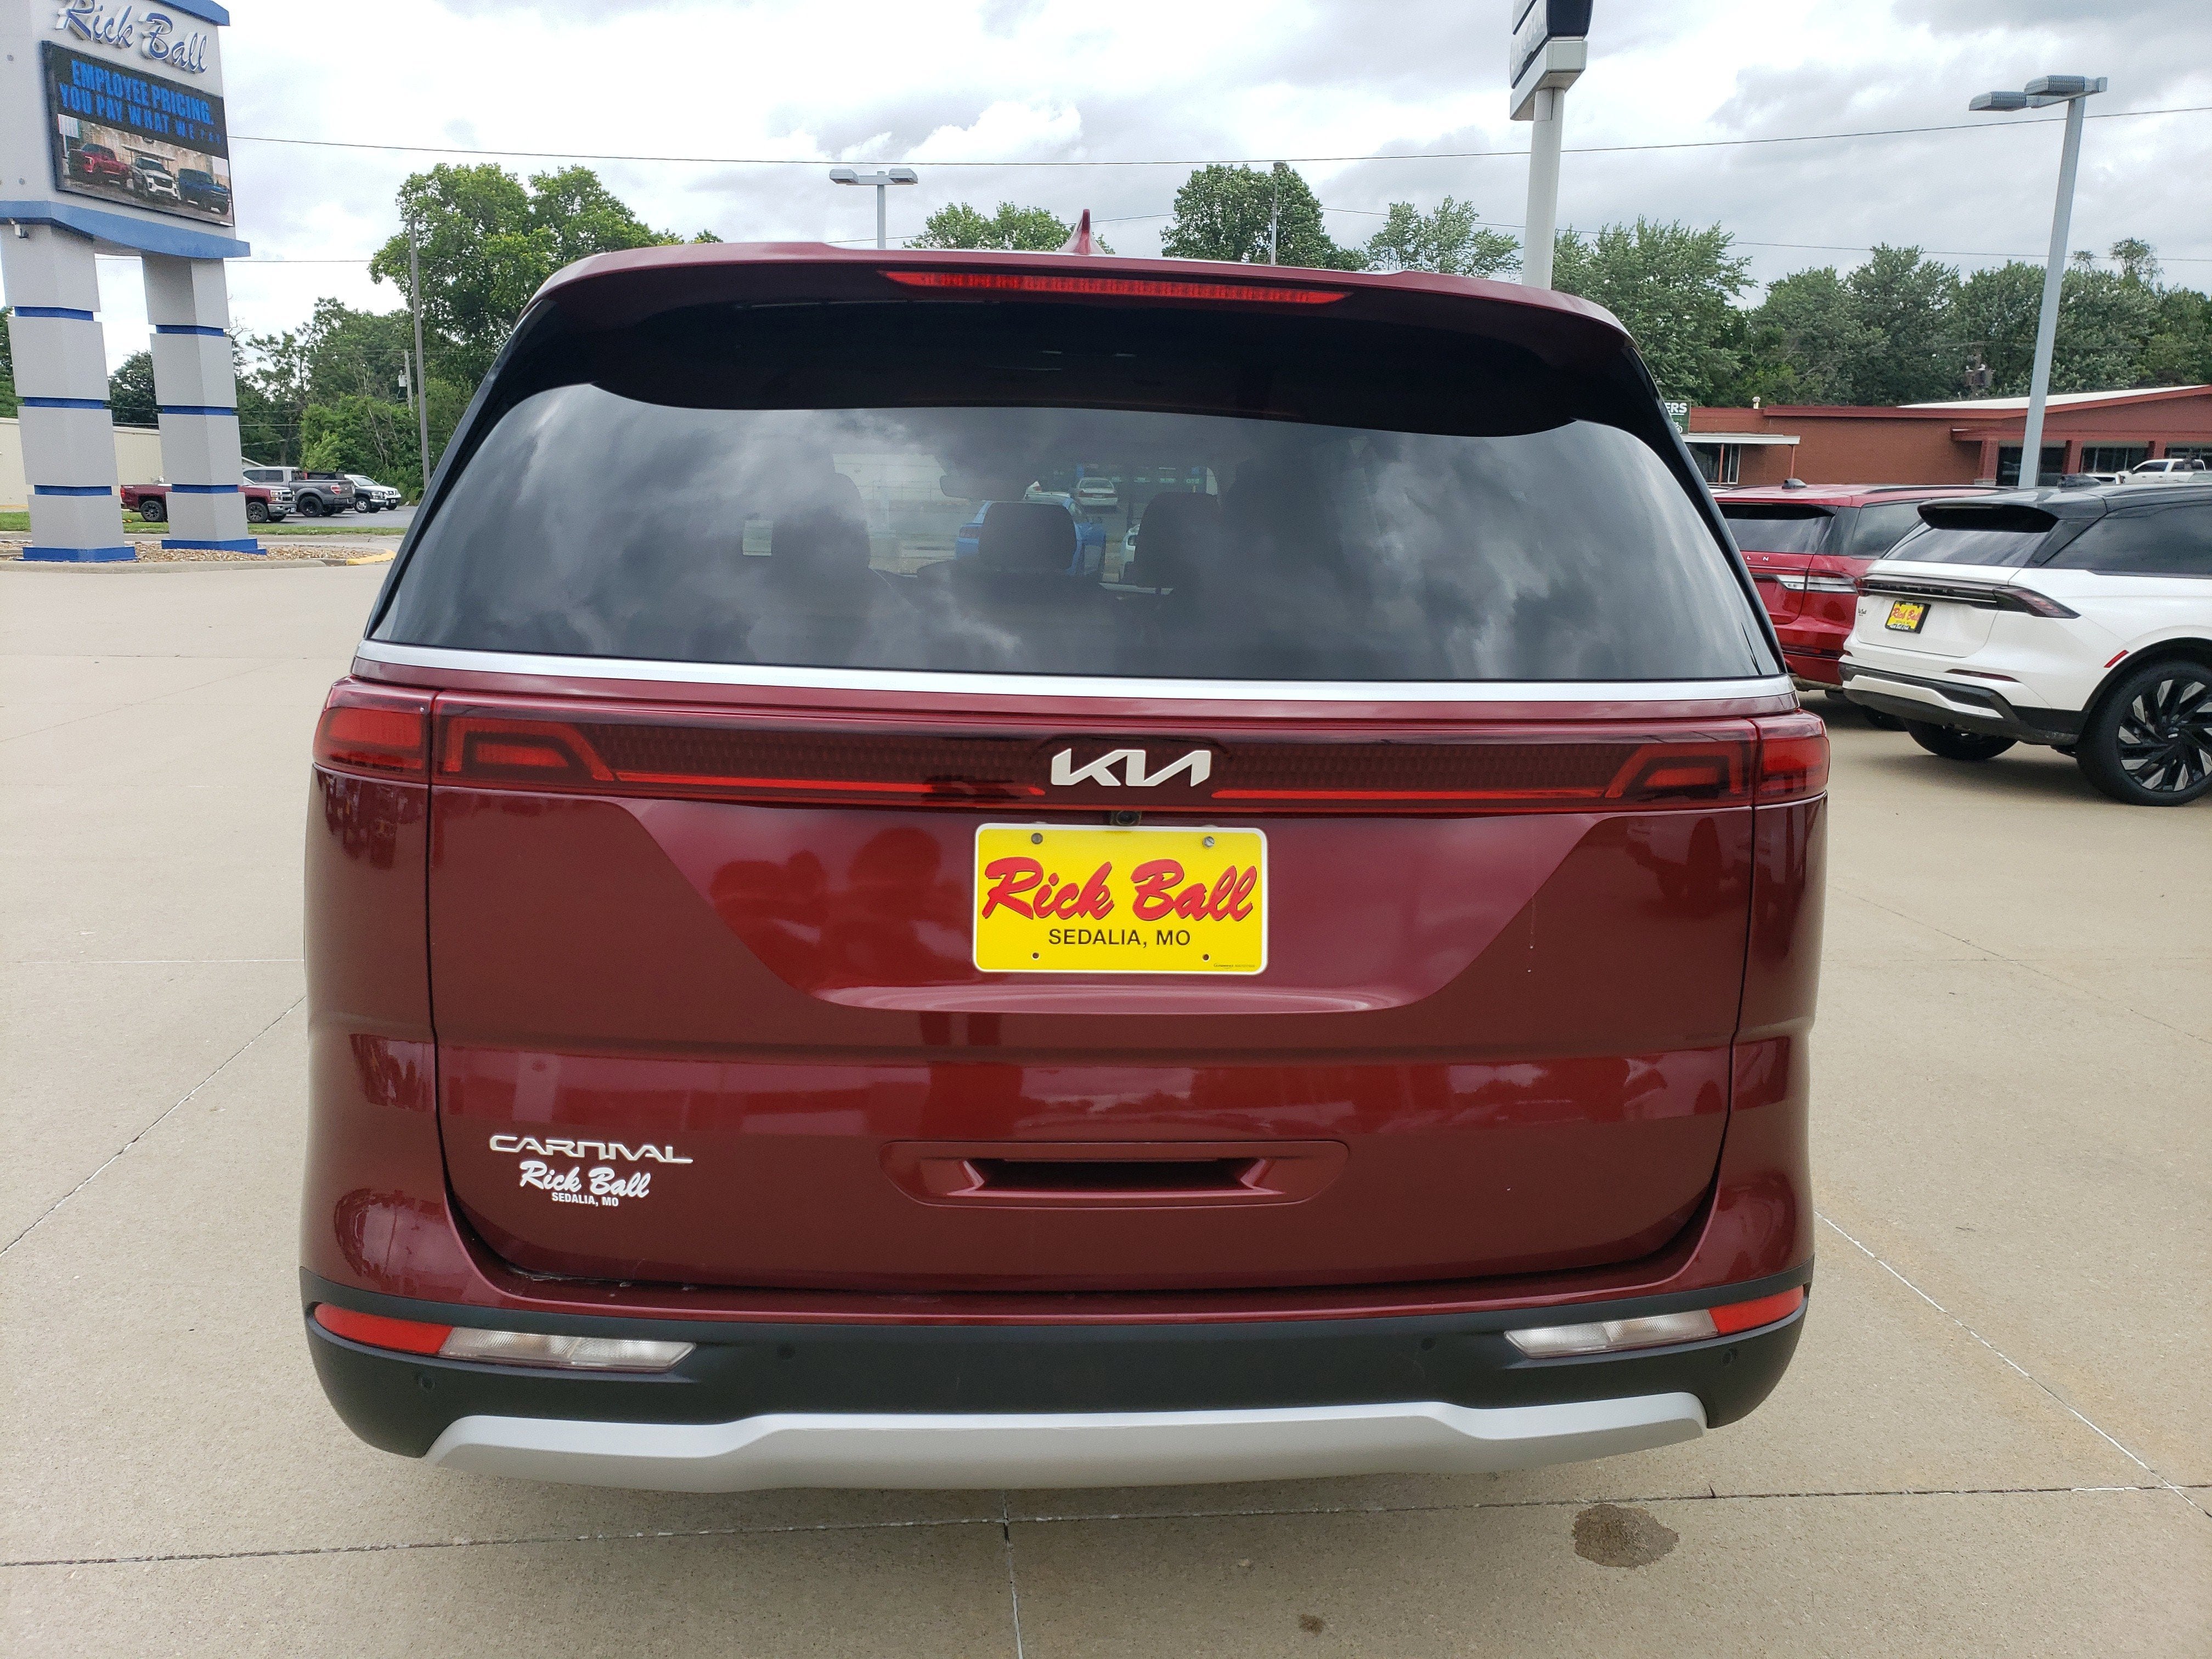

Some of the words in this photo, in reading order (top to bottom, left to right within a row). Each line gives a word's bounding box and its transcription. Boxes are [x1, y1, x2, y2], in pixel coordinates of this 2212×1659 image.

[55, 0, 134, 48] Rick
[139, 13, 208, 74] Ball
[71, 59, 149, 106] EMPLOYEE
[59, 82, 93, 115] YOU
[96, 94, 123, 123] PAY
[128, 105, 169, 135] WHAT
[1051, 748, 1211, 787] KIA
[981, 856, 1115, 921] Rick
[1130, 858, 1257, 922] Ball
[1048, 928, 1147, 948] SEDALIA,
[1156, 929, 1190, 945] MO
[489, 1135, 693, 1164] CARNIVAL
[519, 1160, 582, 1193] Rick
[588, 1166, 651, 1198] Ball
[551, 1192, 599, 1207] SEDALIA,
[602, 1196, 619, 1207] MO
